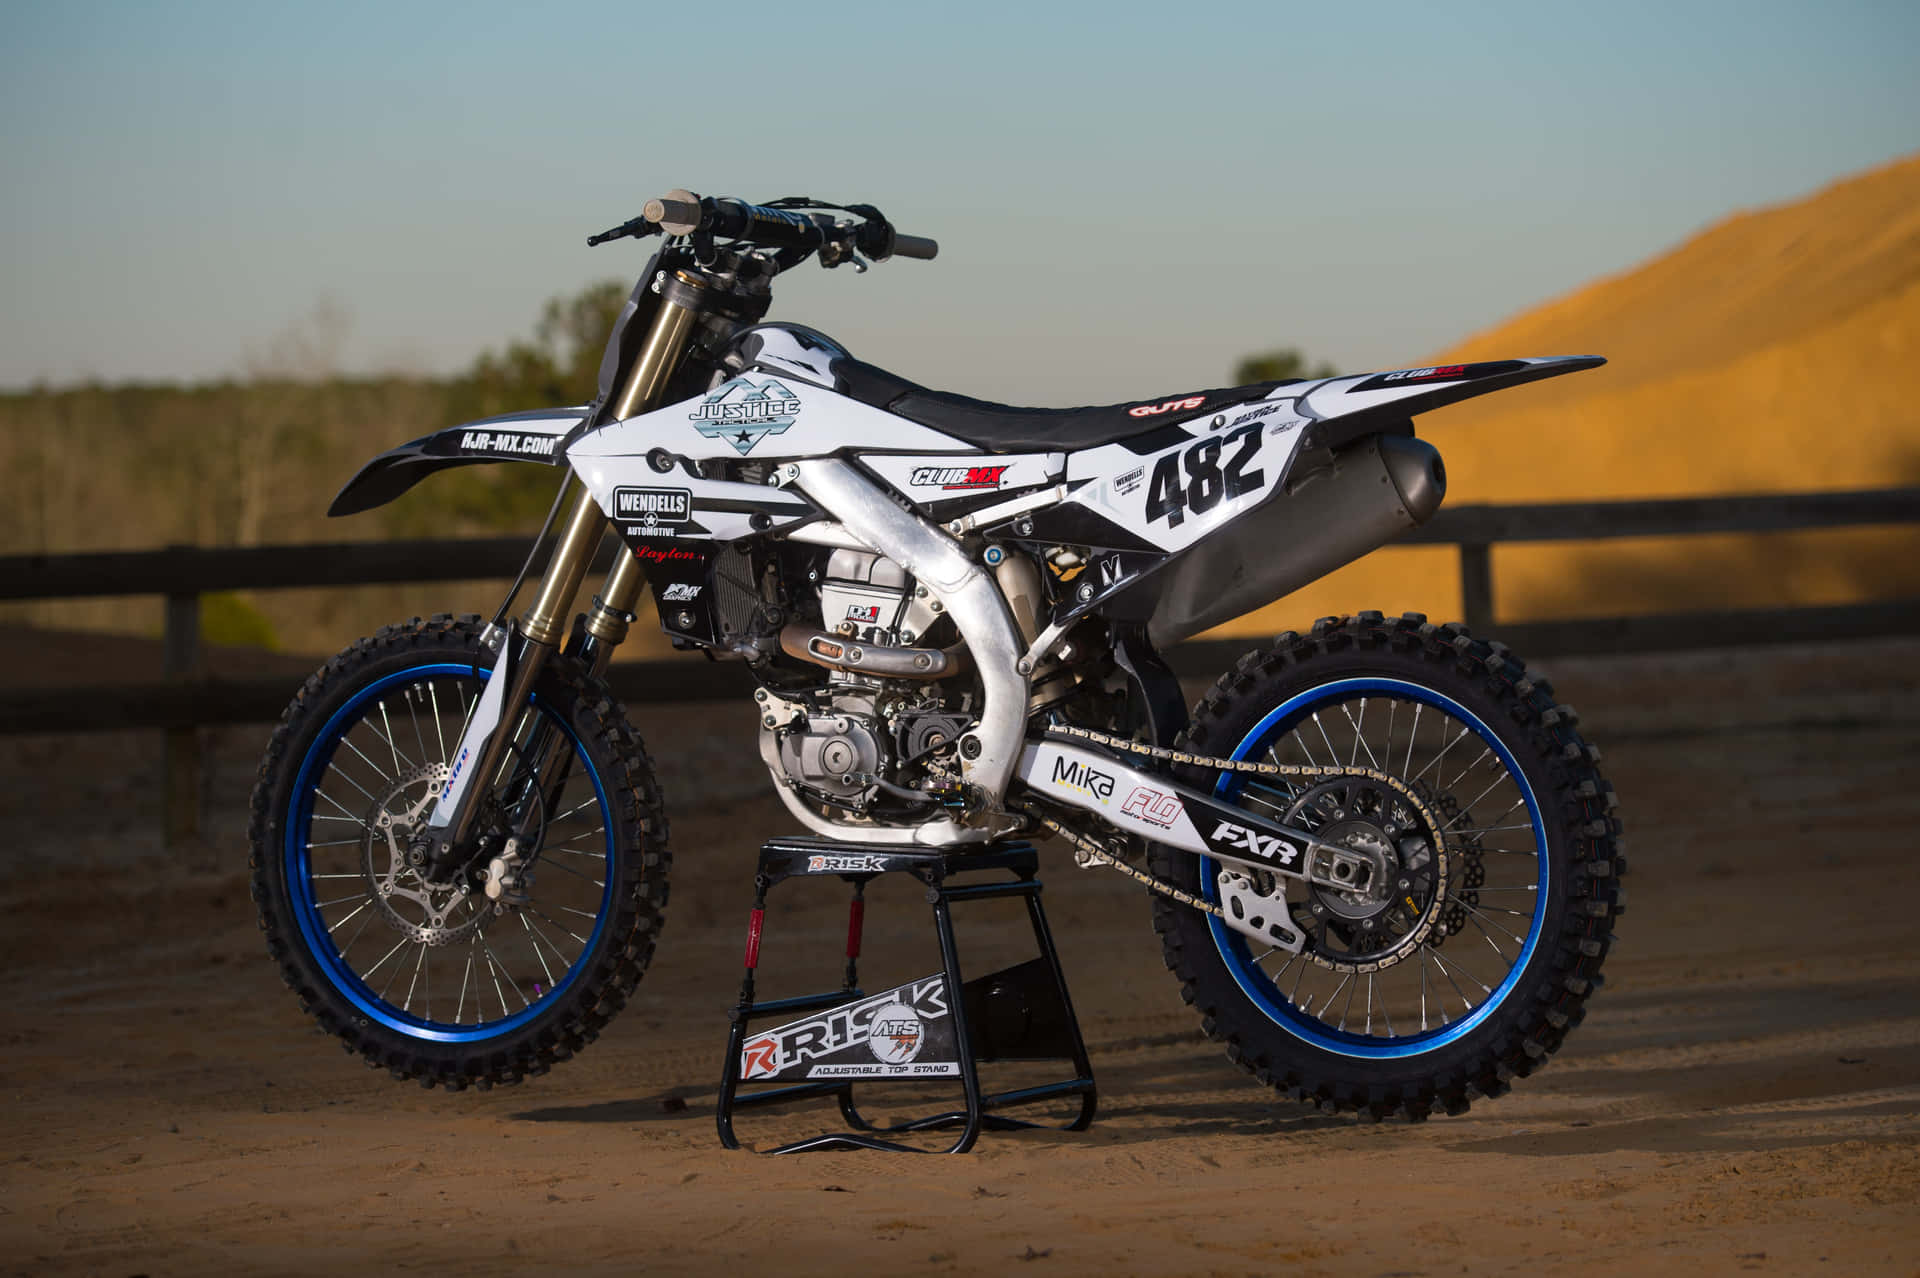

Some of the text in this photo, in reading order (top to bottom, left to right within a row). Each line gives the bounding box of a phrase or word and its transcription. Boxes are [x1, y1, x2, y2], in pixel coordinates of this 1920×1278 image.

[689, 399, 801, 421] JUSTICE
[1128, 396, 1206, 417] GUTS
[460, 431, 556, 455] HJR-MX.COM
[910, 465, 1010, 486] CLUBMX
[1145, 421, 1265, 530] 482
[619, 493, 686, 513] WENDELLS
[627, 526, 676, 537] AUTOMOTIVE
[635, 545, 695, 564] Layton
[1051, 755, 1116, 800] Mika
[1121, 786, 1184, 825] FLO
[1210, 818, 1299, 865] FXR
[823, 855, 889, 872] RISK
[815, 1065, 949, 1075] ADJUSTABLE TOP STAND
